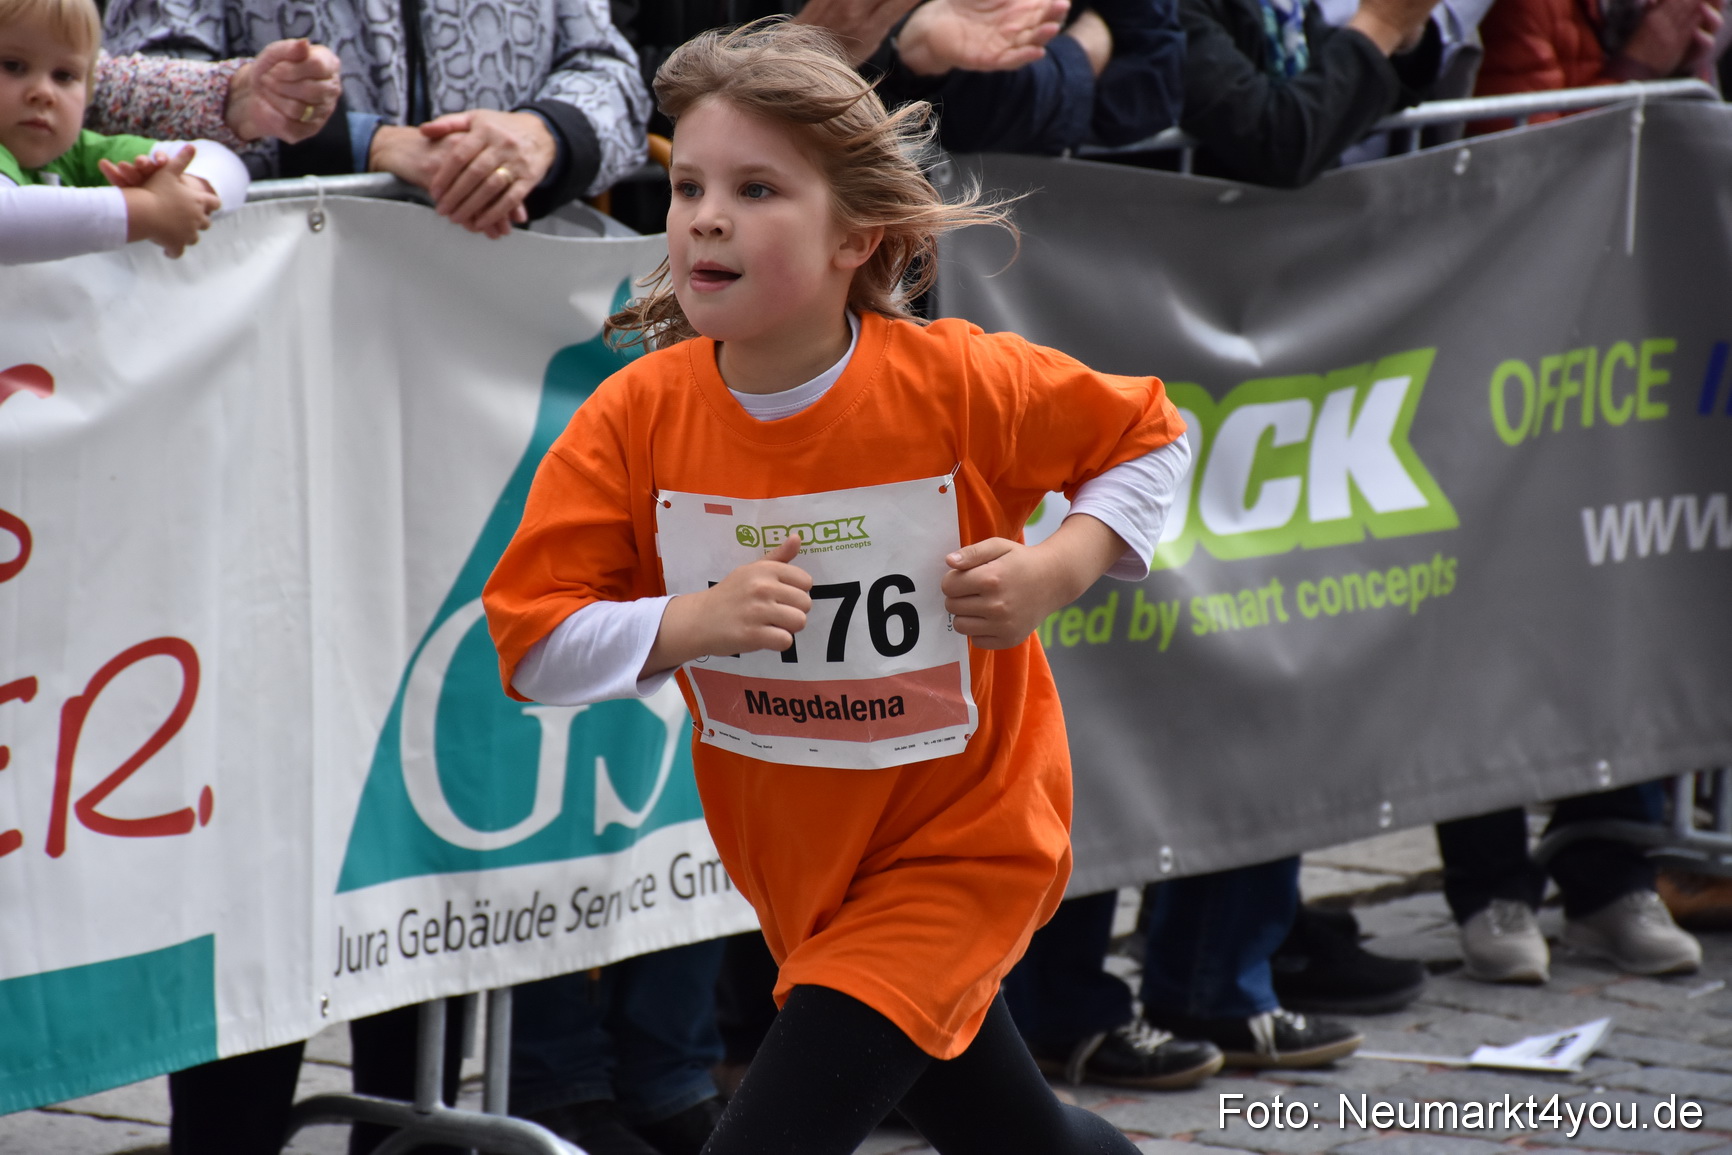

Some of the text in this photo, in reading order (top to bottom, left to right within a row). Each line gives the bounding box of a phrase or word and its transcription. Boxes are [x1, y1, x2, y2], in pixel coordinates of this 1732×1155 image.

[1488, 337, 1678, 447] OFFICE
[762, 516, 868, 547] BOCK
[810, 545, 834, 554] smart
[835, 540, 872, 551] concepts
[1128, 588, 1180, 652] by
[1190, 576, 1290, 636] smart
[1296, 553, 1458, 620] concepts
[744, 689, 905, 724] Magdalena
[334, 926, 388, 977] Jura
[398, 890, 557, 959] Gebäude
